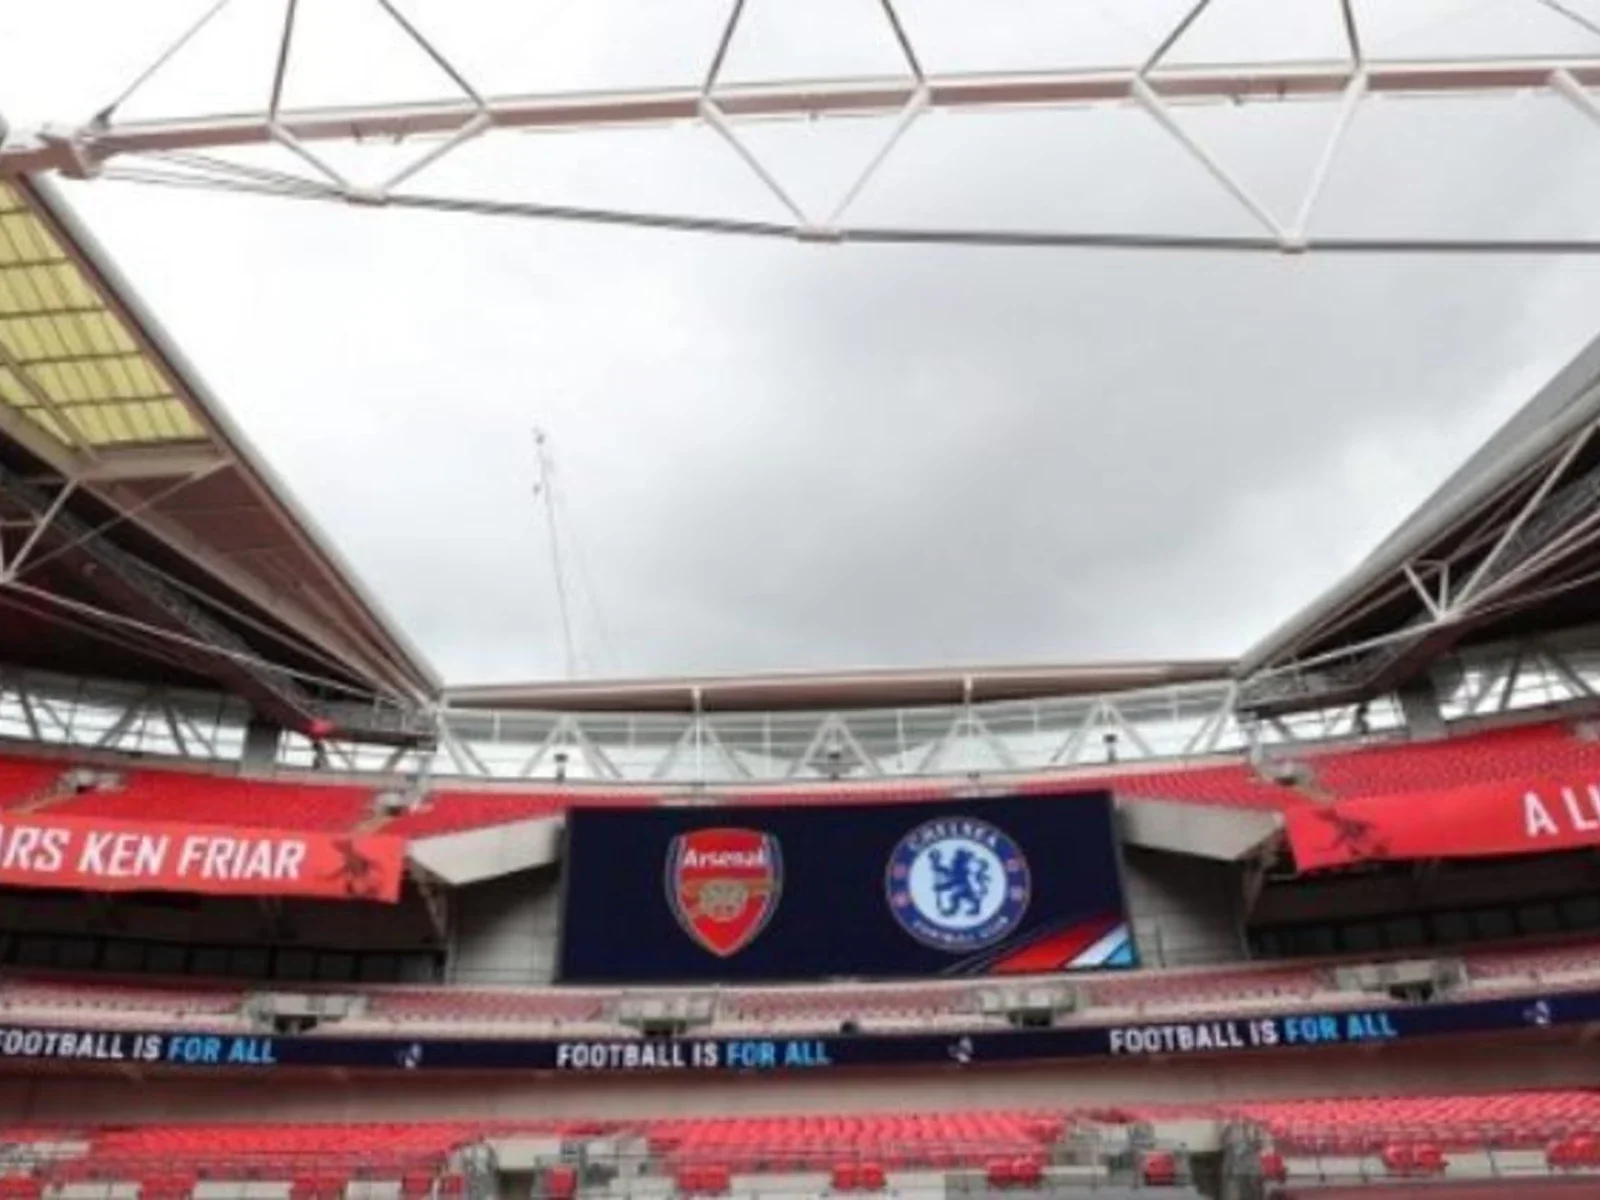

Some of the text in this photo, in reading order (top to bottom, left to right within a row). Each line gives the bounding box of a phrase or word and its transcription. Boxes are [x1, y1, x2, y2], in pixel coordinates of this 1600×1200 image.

[1523, 791, 1559, 837] A
[0, 825, 306, 880] RS KEN FRIAR
[684, 848, 765, 868] Arsenal
[133, 1036, 161, 1059] IS
[167, 1036, 219, 1062] FOR
[228, 1039, 276, 1063] ALL
[1110, 1012, 1397, 1054] FOOTBALL IS FOR ALL
[556, 1041, 832, 1067] FOOTBALL IS FOR ALL
